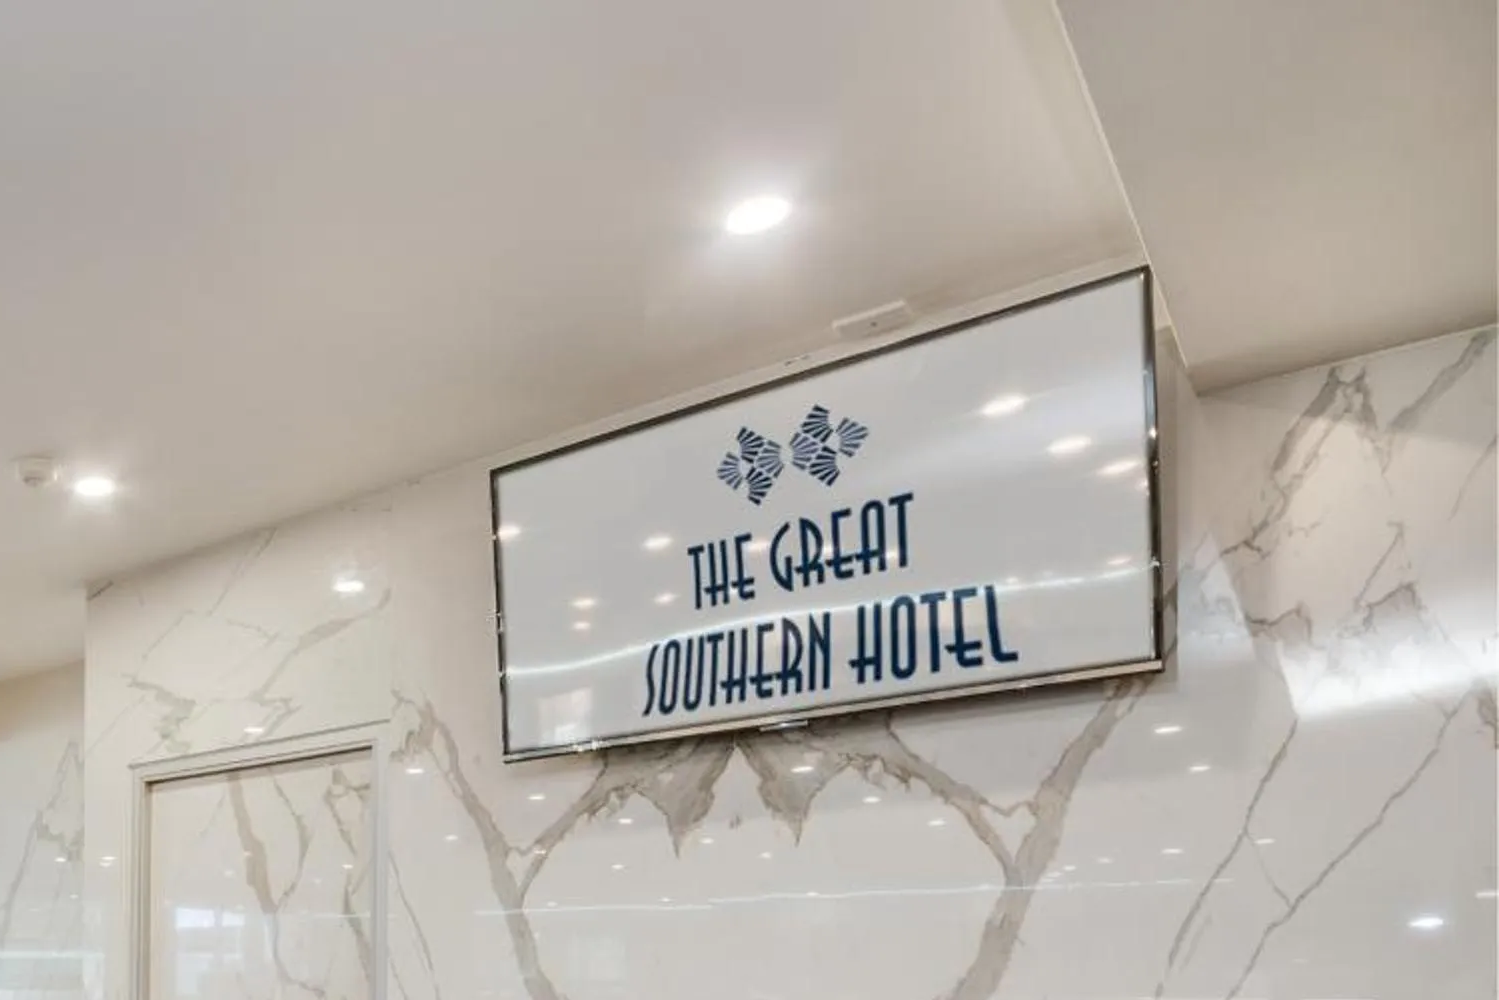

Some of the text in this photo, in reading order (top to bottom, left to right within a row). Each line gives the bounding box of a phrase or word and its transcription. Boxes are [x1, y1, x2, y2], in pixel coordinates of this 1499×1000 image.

[687, 492, 914, 610] THE GREAT
[642, 584, 1019, 717] SOUTHERN HOTEL
